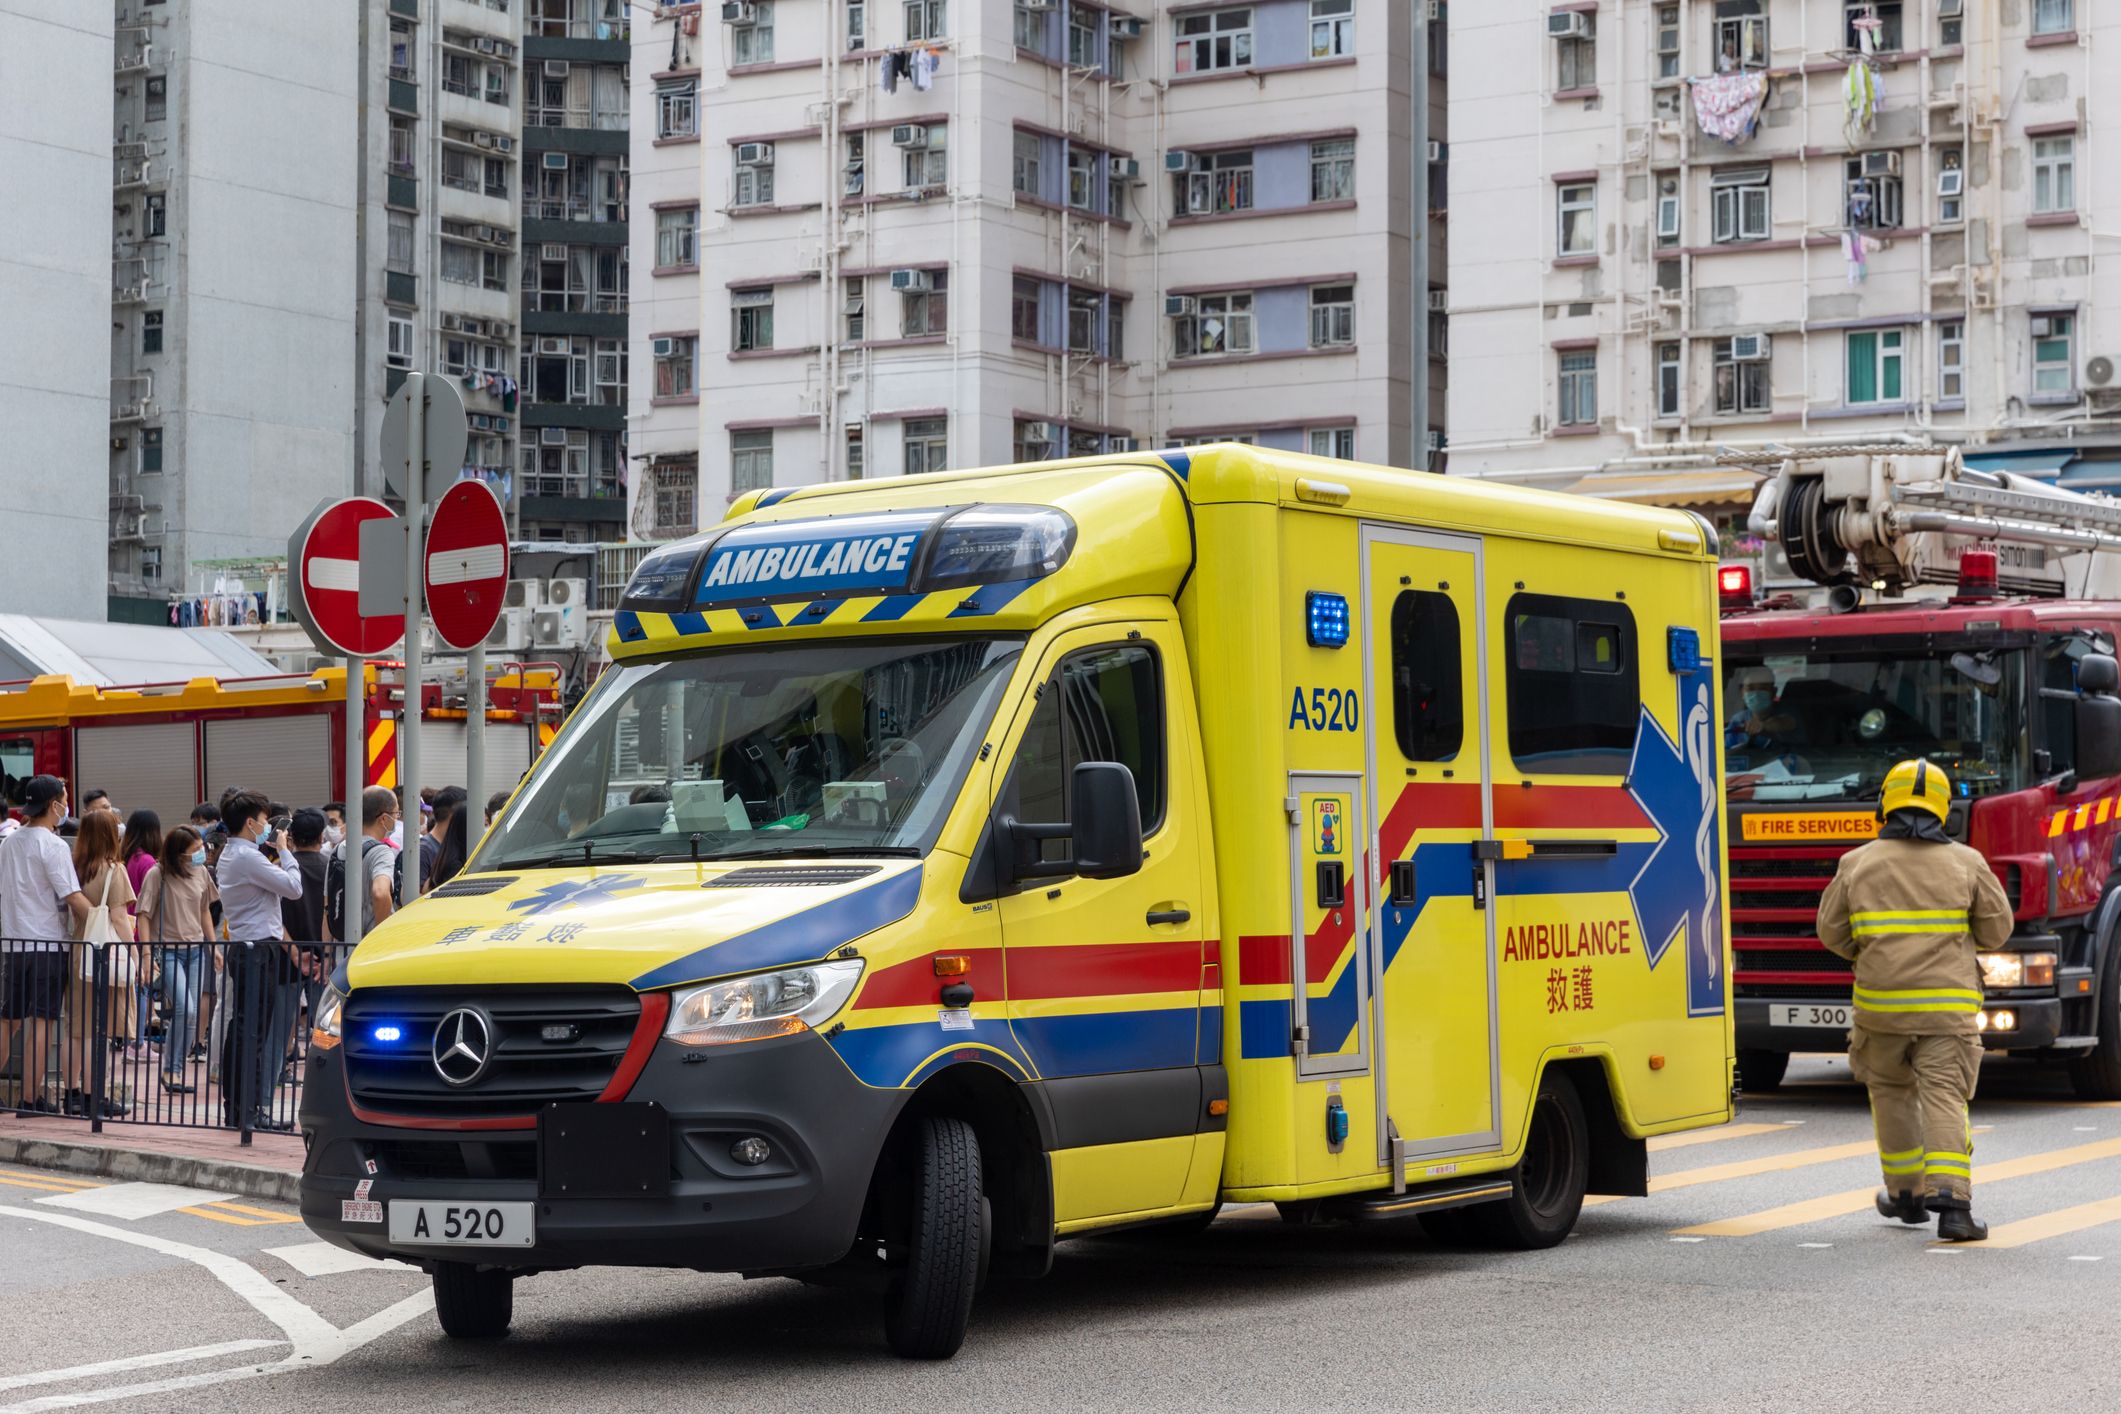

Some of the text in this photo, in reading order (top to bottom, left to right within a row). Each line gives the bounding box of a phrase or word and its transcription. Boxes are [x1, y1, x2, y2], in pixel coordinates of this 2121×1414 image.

[704, 535, 917, 588] AMBULANCE
[1288, 686, 1359, 733] A520
[1319, 803, 1335, 813] AED
[1761, 819, 1873, 834] FIRE SERVICES
[1503, 920, 1631, 962] AMBULANCE
[1547, 965, 1594, 1014] 救護
[1788, 1008, 1846, 1025] F 300
[413, 1207, 504, 1239] A 520
